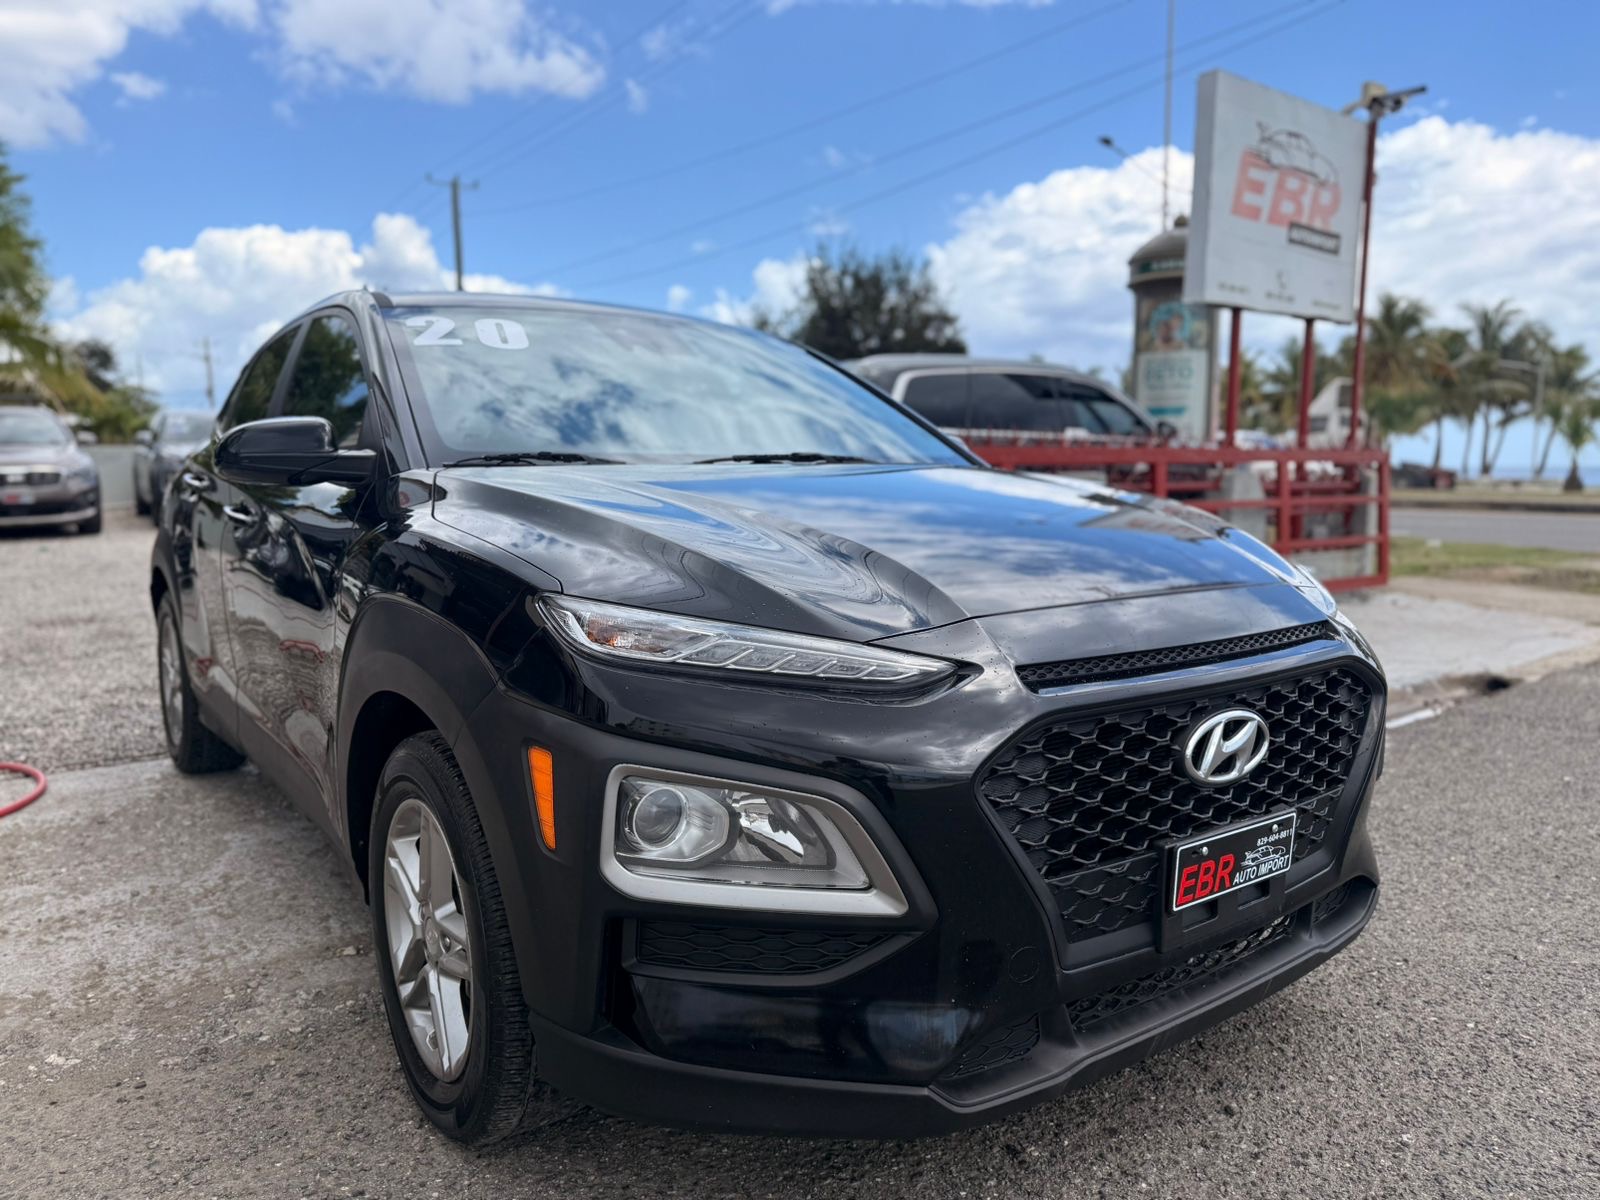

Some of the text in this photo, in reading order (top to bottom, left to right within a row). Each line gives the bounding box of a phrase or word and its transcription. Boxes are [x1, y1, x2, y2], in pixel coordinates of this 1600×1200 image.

[1231, 148, 1343, 232] EBR
[404, 315, 529, 350] 20
[1177, 853, 1289, 905] EBR AUTO IMPORT
